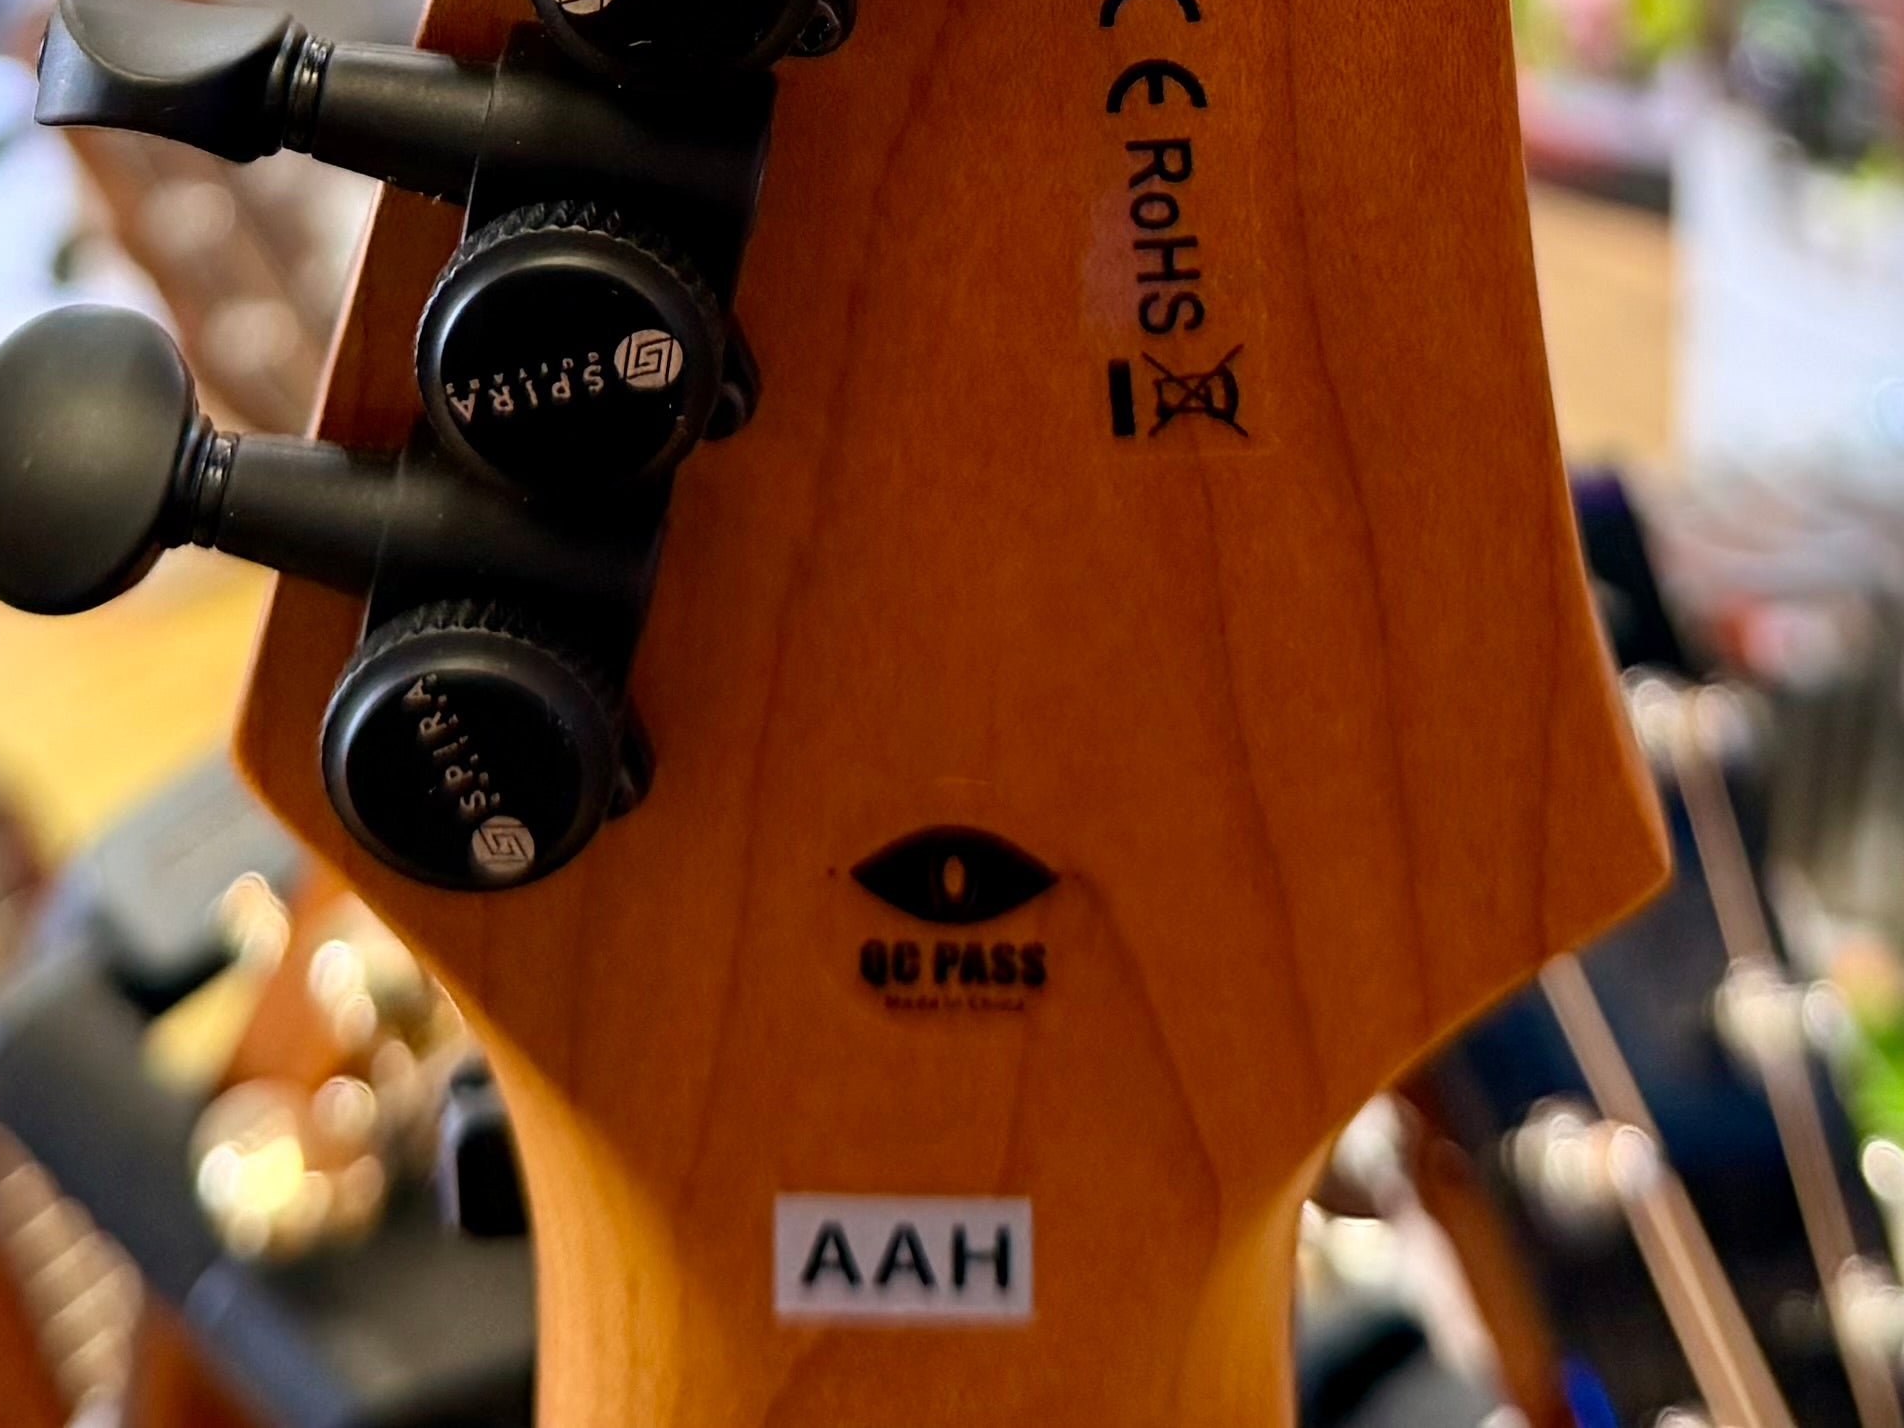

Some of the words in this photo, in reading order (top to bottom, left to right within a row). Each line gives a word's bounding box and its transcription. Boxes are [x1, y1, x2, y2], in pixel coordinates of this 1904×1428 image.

[1125, 138, 1206, 335] RoHS
[448, 363, 605, 424] SPIRA
[403, 678, 487, 822] SPIRA
[859, 938, 922, 988] QC
[934, 940, 1047, 988] PASS
[800, 1220, 1013, 1294] AAH
